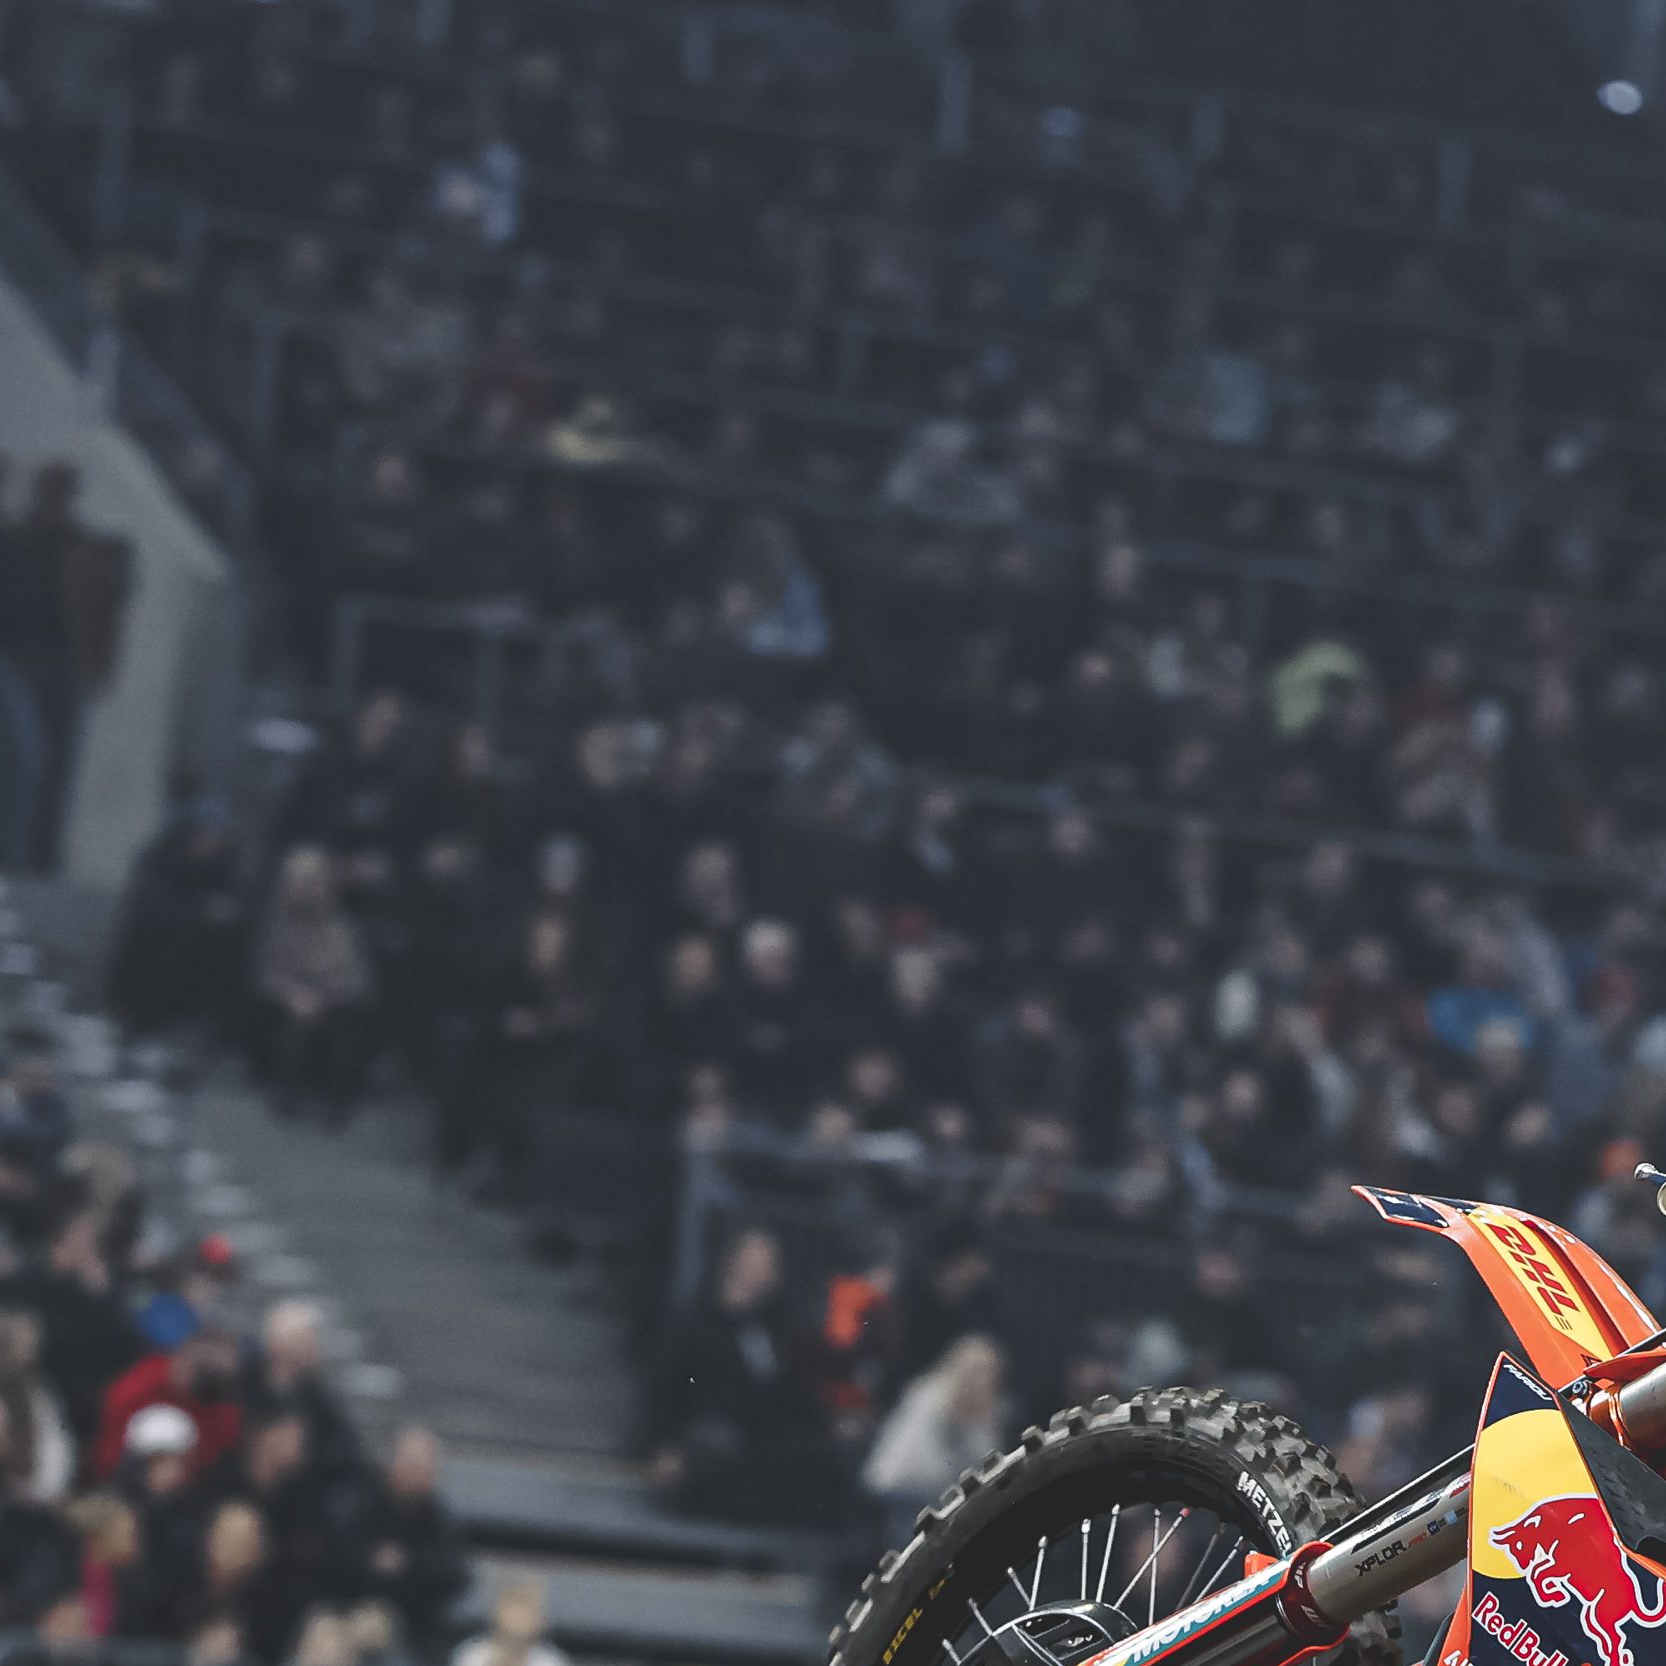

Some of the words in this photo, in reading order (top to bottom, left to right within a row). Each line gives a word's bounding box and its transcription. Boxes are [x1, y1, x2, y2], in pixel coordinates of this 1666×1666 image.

[1488, 1223, 1580, 1317] DHL
[1237, 1470, 1292, 1555] METZE
[1354, 1539, 1408, 1577] XPLOR
